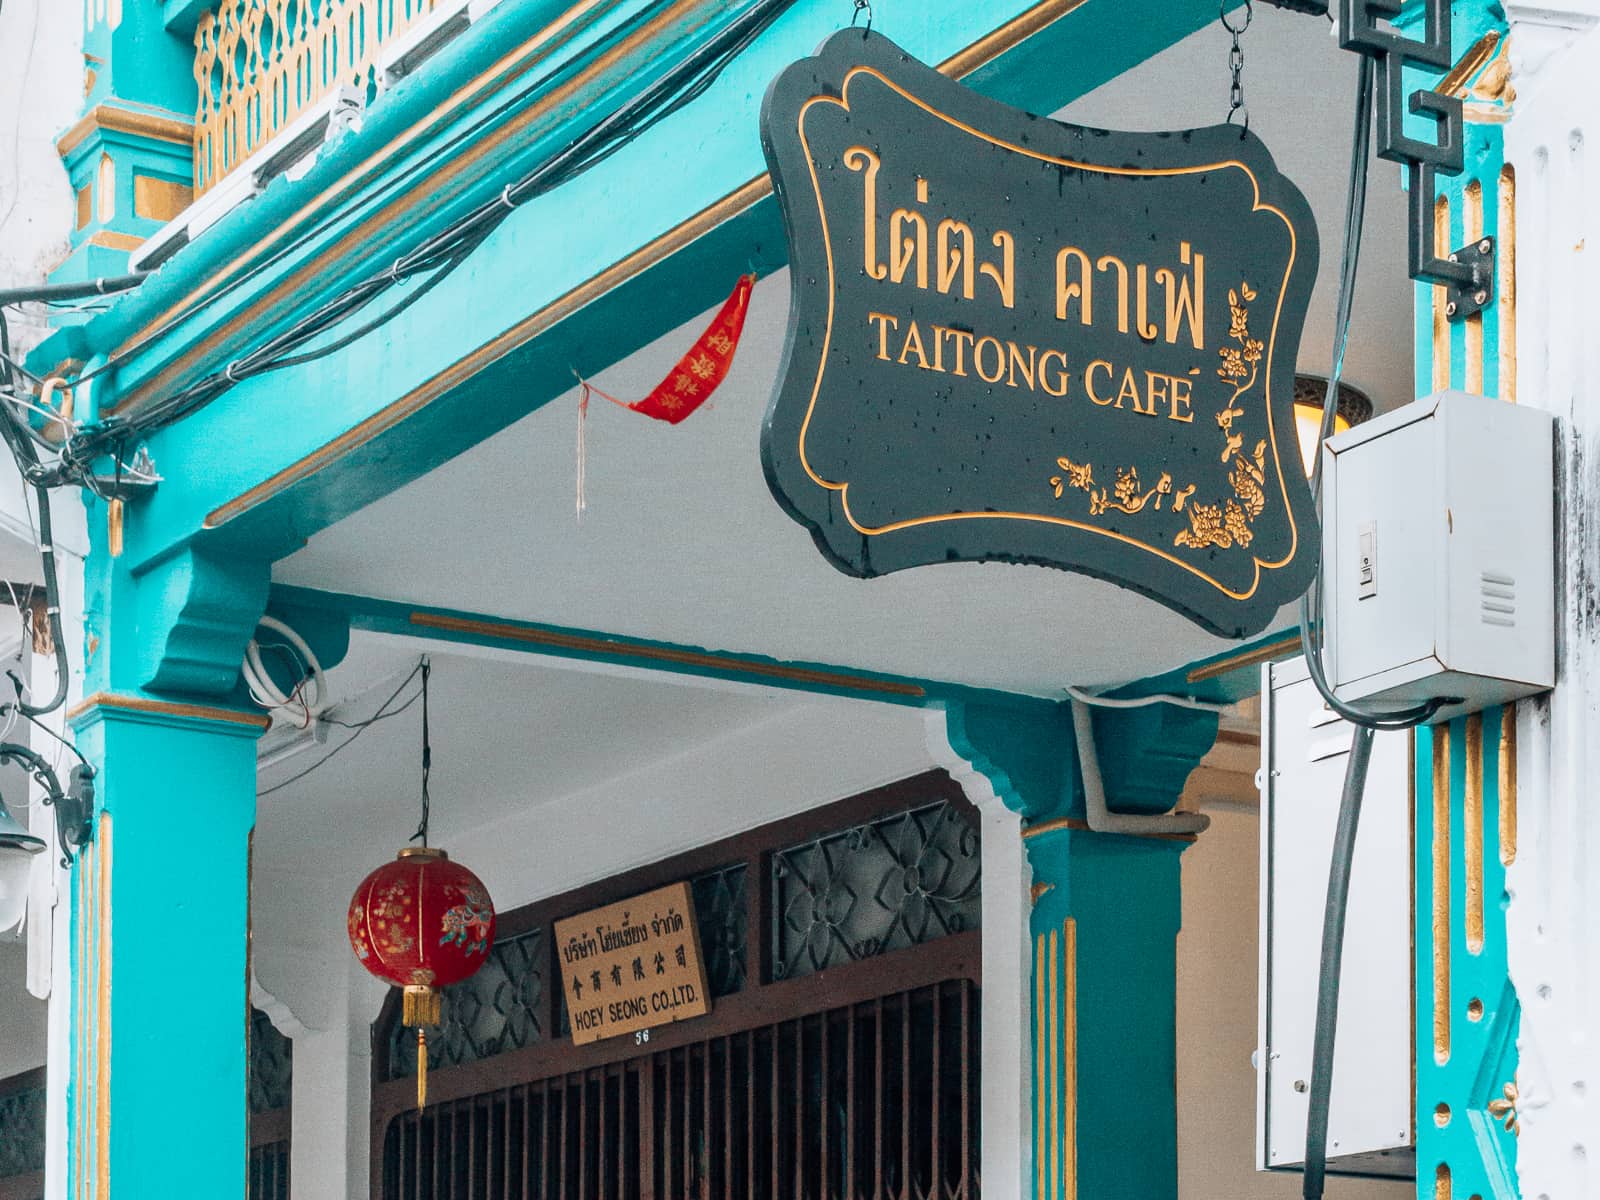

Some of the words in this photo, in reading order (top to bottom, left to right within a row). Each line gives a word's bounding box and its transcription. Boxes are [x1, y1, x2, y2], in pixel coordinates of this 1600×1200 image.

[843, 145, 1014, 308] ใต่ตง
[1055, 241, 1205, 350] คาเฟ่
[868, 312, 1070, 396] TAITONG
[1084, 360, 1201, 423] CAFÉ
[563, 932, 598, 963] บริษัท
[651, 907, 683, 937] จำกัด
[575, 1007, 604, 1031] HOEY
[608, 996, 647, 1023] SEONG
[635, 1029, 649, 1046] 56
